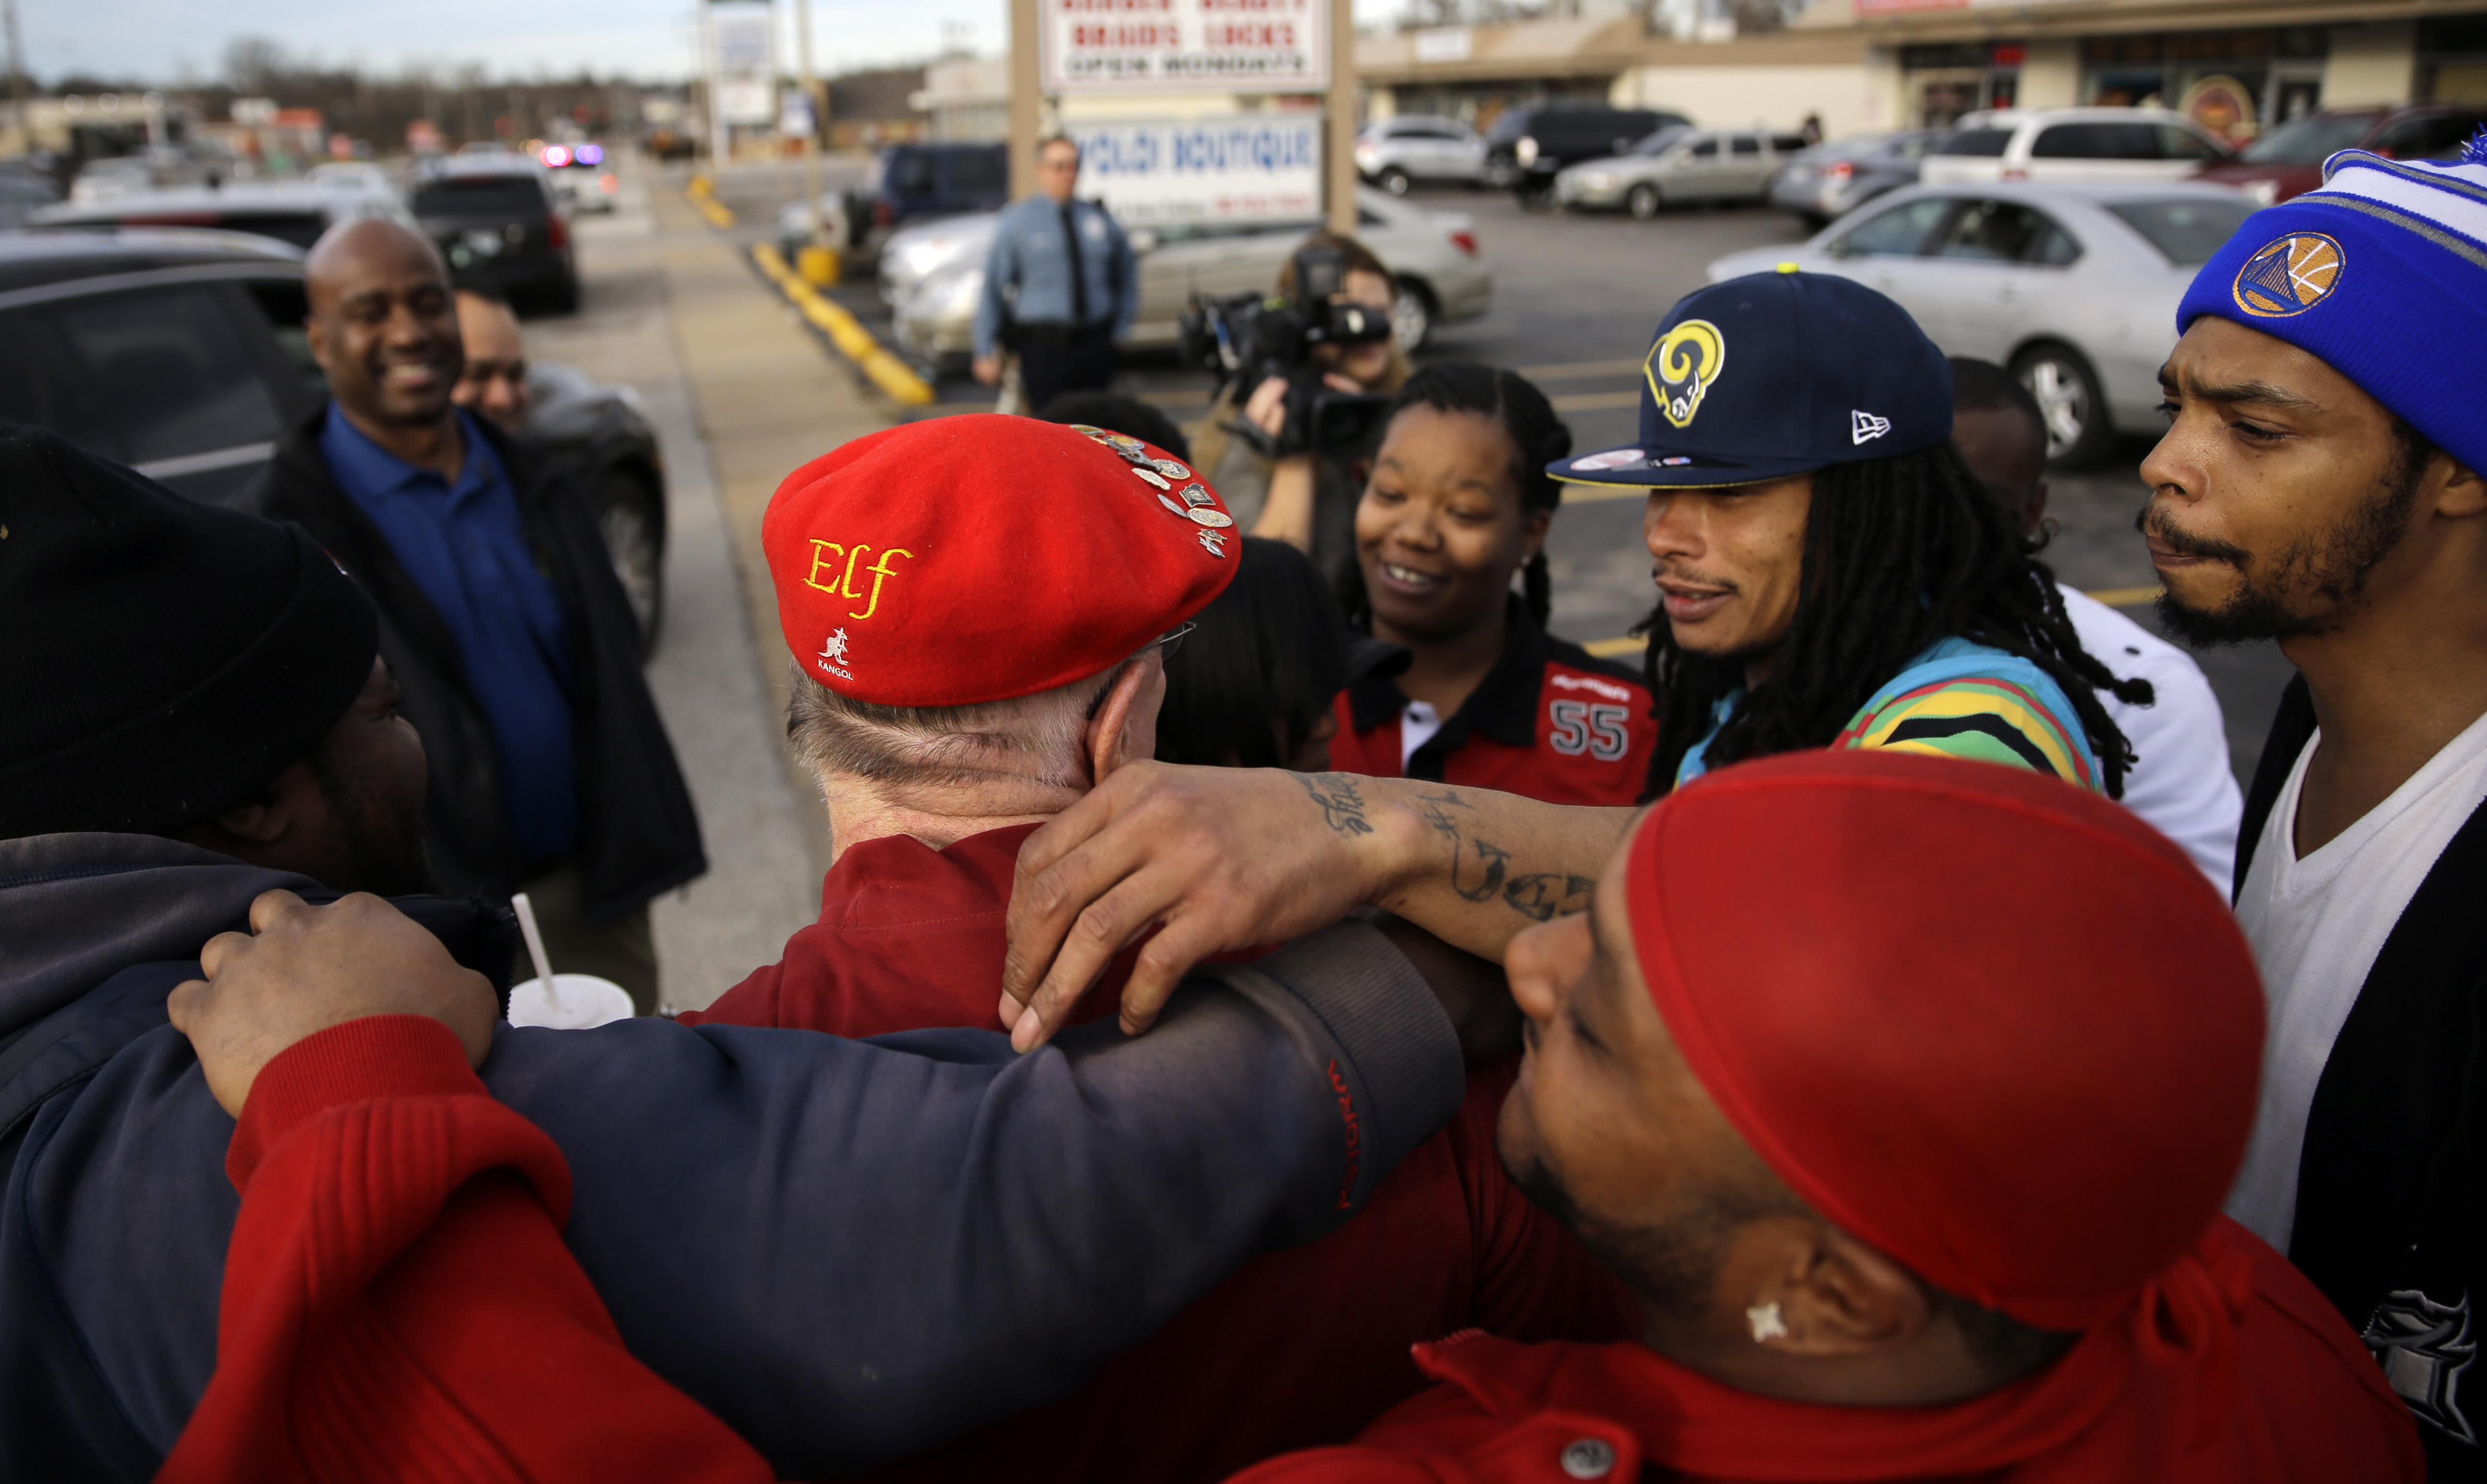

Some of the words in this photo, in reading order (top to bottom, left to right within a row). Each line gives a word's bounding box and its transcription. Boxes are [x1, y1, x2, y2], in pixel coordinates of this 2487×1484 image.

[801, 539, 914, 620] Elf
[818, 659, 854, 681] KANGOL
[1550, 699, 1630, 762] 55
